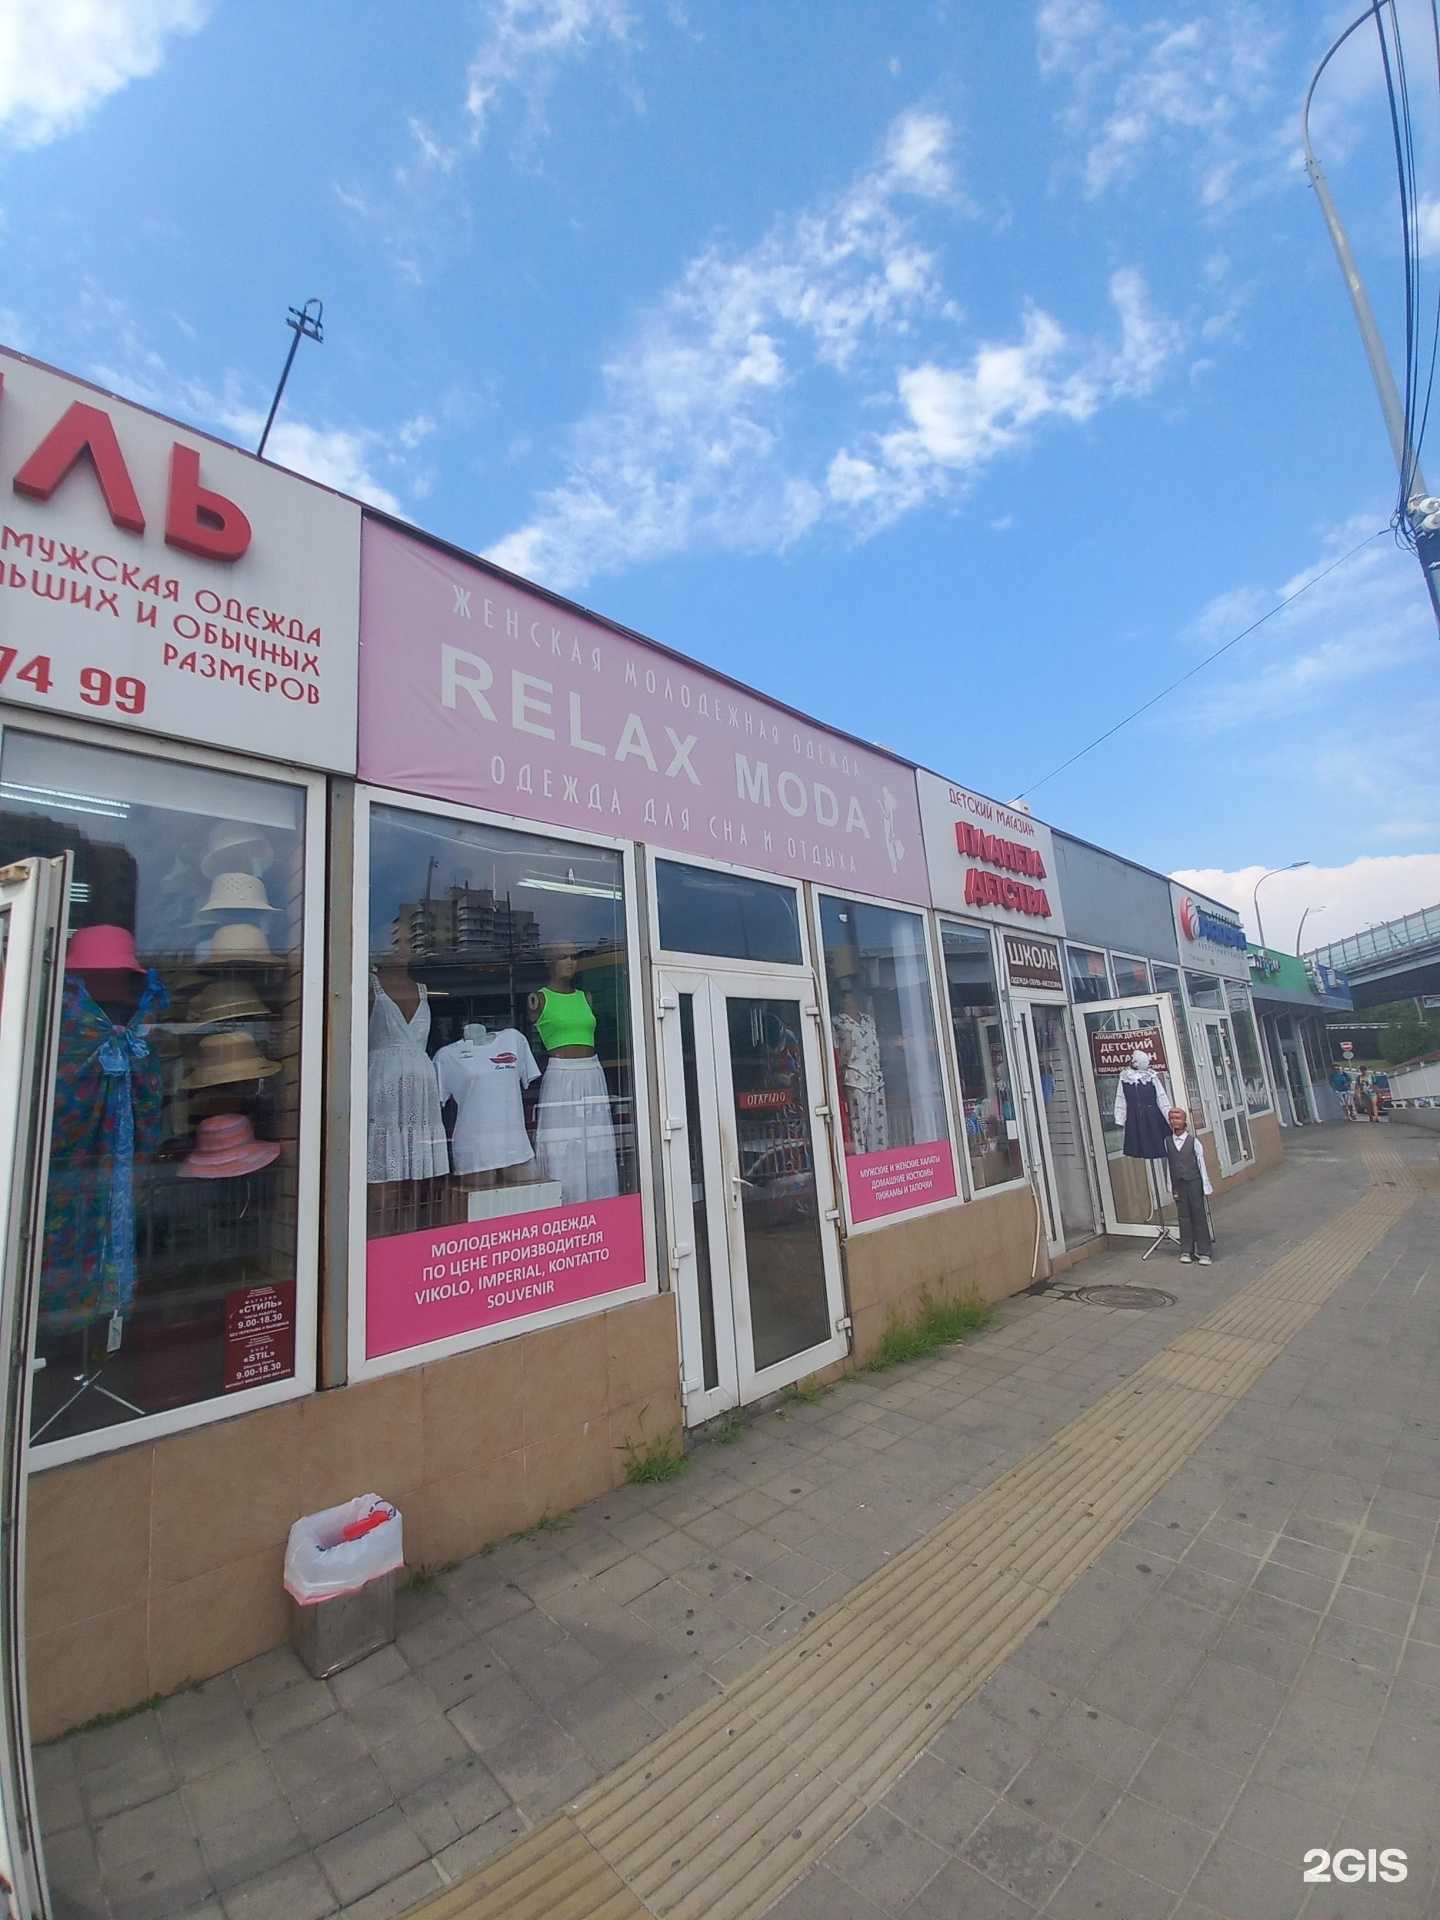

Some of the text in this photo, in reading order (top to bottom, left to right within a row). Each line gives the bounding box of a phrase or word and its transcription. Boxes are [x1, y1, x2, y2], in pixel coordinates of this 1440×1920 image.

[0, 372, 252, 562] ЛЬ
[2, 525, 321, 647] МУЖСКАЯ ОДЕЖДА
[137, 601, 158, 628] И
[173, 615, 320, 677] ОБЫЧНЫХ
[163, 643, 320, 705] РАЗМЕРОВ
[452, 584, 601, 673] ЖЕНСКАЯ
[625, 662, 779, 745] МОЛОДЕЖНАЯ
[80, 667, 146, 714] 99
[441, 642, 871, 839] RELAX MODA
[491, 755, 857, 874] ОДЕЖДА ДЛЯ СНА И ОТДЫХА
[949, 788, 1035, 837] ДЕТСКИЙ МАГАЗИН
[1006, 942, 1058, 971] ШКОЛА
[1100, 1038, 1154, 1053] ДЕТСКИЙ
[1101, 1052, 1158, 1064] МАГАН
[423, 1231, 603, 1282] ПО ЦЕНЕ ПРОИЗВОДИТЕЛЯ
[431, 1214, 597, 1258] МОЛОДЕЖНАЯ ОДЕЖДА
[415, 1248, 609, 1305] VIKOLO, IMPERIAL, KONTATTO
[487, 1281, 555, 1309] SOUVENIR
[238, 1313, 282, 1329] 9.00-18.30
[236, 1362, 281, 1380] 9.00-18.30
